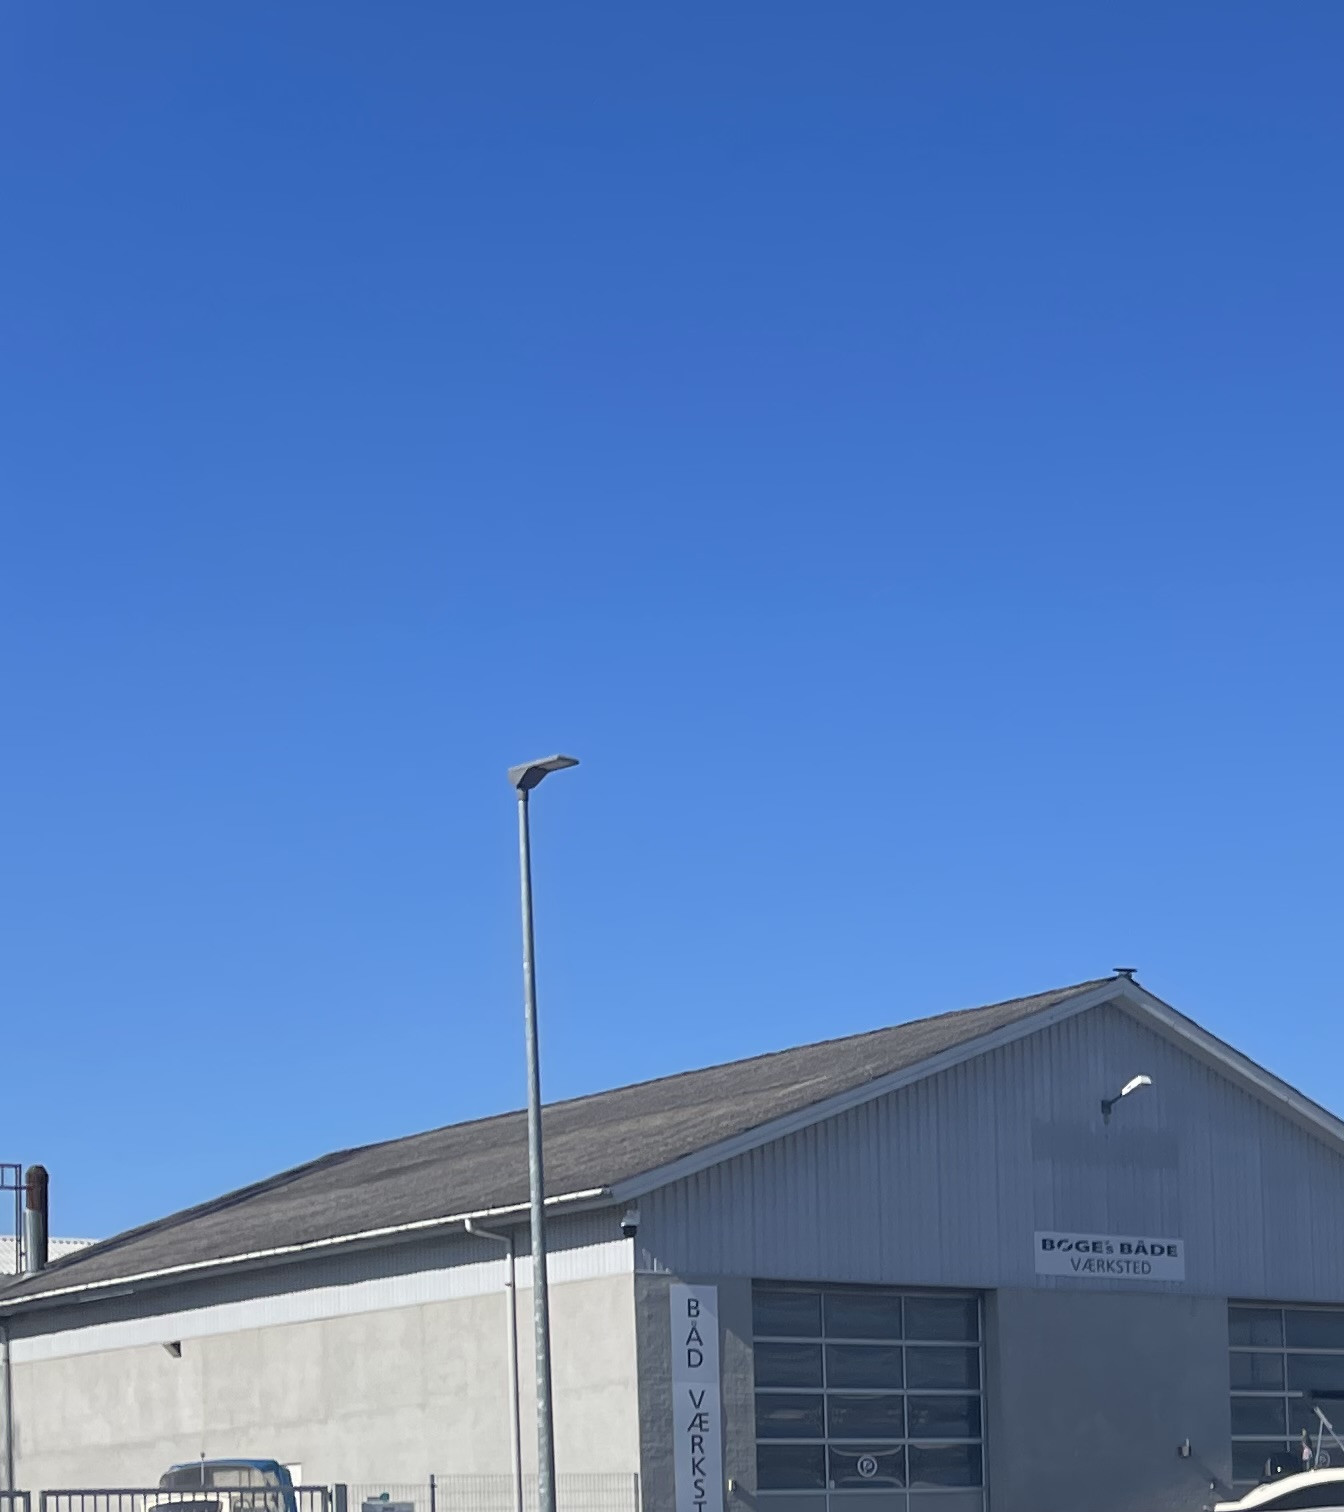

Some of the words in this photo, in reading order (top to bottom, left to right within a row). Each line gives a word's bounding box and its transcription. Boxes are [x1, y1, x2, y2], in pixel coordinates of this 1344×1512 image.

[1119, 1239, 1178, 1257] BÅDE
[1070, 1257, 1152, 1275] VÆRKSTED
[686, 1298, 704, 1368] BÅD
